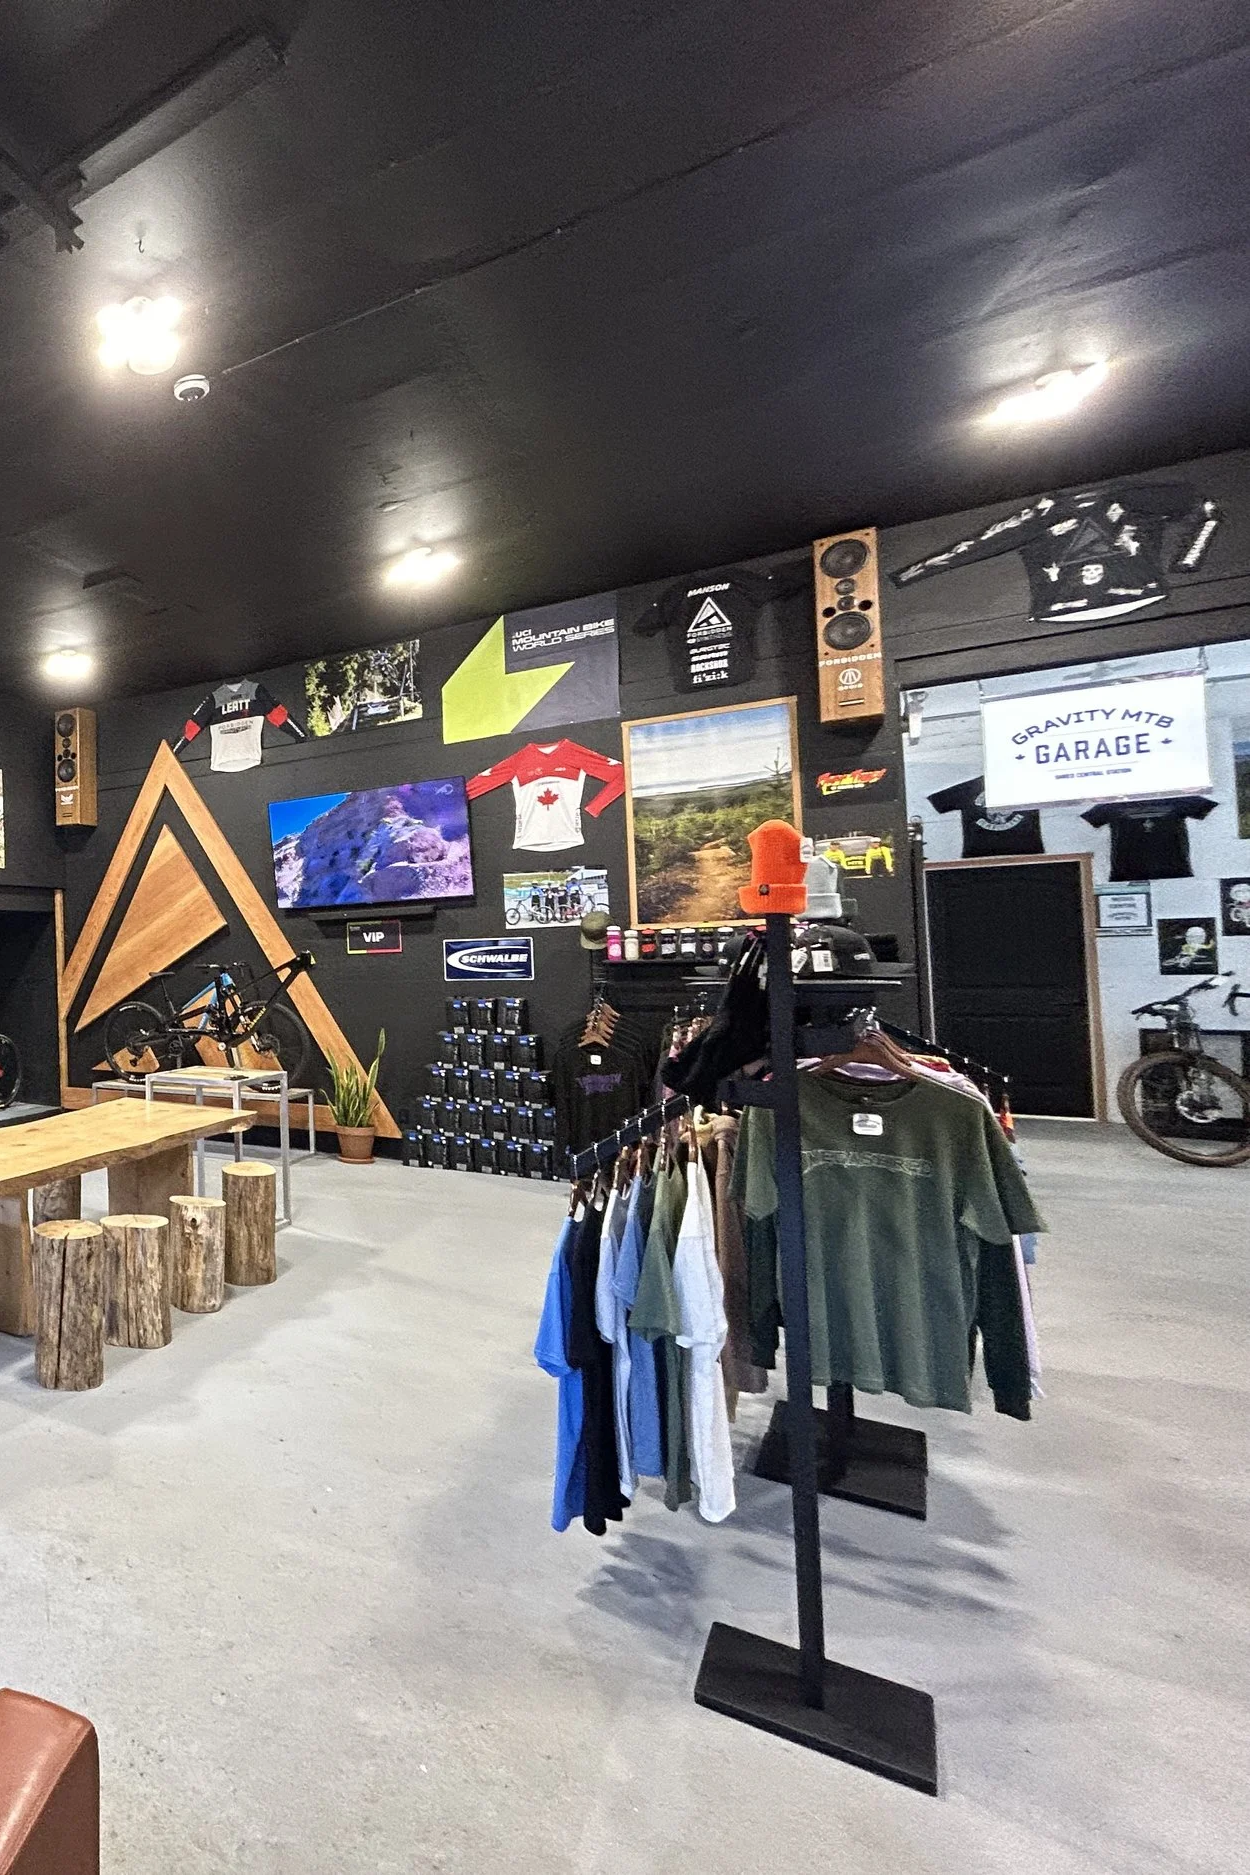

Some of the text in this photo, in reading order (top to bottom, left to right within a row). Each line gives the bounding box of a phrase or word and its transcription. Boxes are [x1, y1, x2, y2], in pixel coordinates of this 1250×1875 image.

[512, 618, 615, 645] MOUNTAIN BIKE
[512, 625, 615, 652] WORLD SERIES
[515, 628, 532, 638] UCI
[819, 652, 882, 668] FORBIDDEN
[221, 698, 250, 716] LEATT
[1011, 708, 1175, 746] GRAVITY MTB
[1035, 732, 1152, 765] GARAGE
[363, 931, 385, 943] VIP
[461, 953, 528, 964] SCHWALBE
